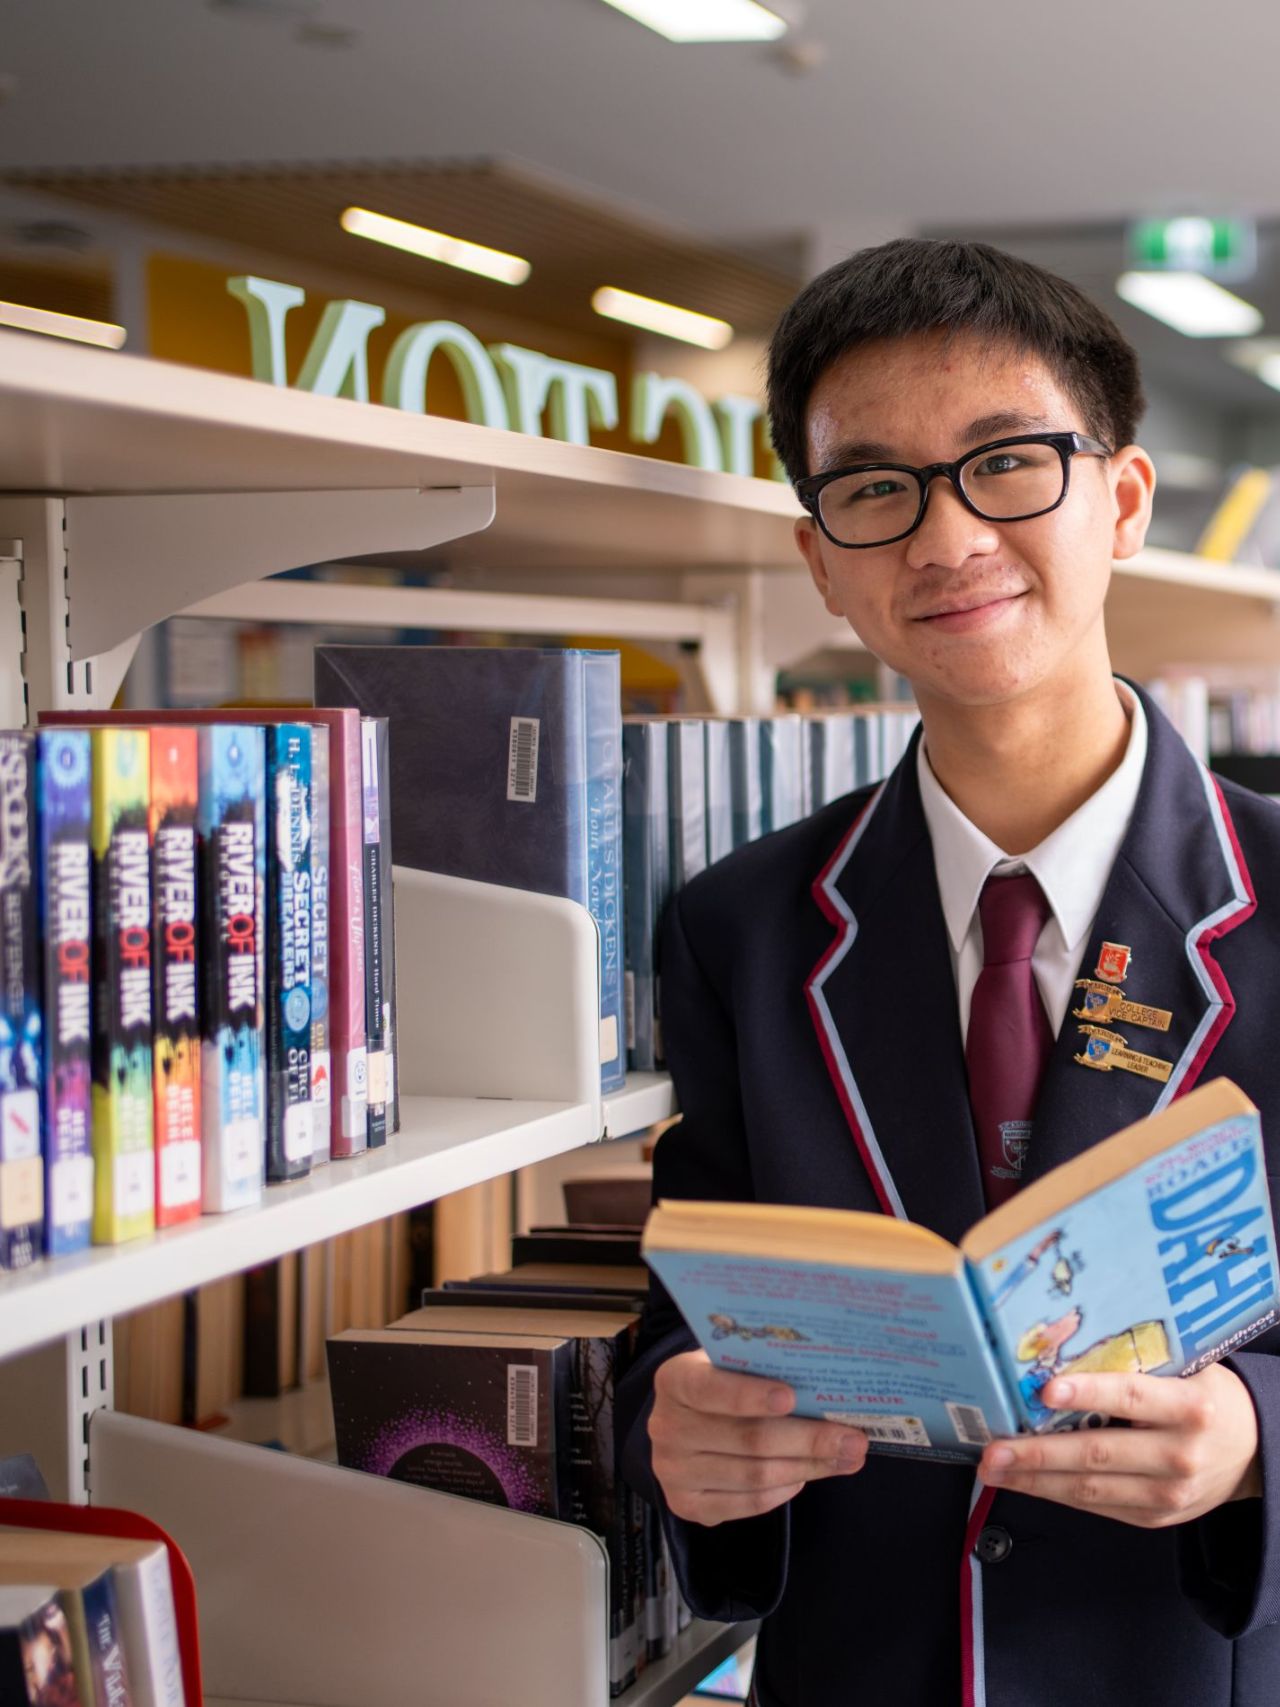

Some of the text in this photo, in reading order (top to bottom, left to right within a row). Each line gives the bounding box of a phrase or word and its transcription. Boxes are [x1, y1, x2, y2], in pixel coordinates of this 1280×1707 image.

[56, 842, 90, 1044] RIVER OF INK
[118, 830, 151, 1029] RIVER OF INK
[164, 827, 196, 1021] RIVER OF INK
[227, 823, 257, 1011] RIVER OF INK
[281, 872, 296, 990] BREAKERS
[292, 870, 311, 986] SECRET
[311, 866, 329, 977] SECRET
[589, 859, 603, 925] Novel
[602, 872, 617, 986] DICKENS
[1119, 1002, 1159, 1019] COLLEGE
[298, 1049, 309, 1099] CIRC
[1149, 1146, 1275, 1364] DAHL
[1198, 1308, 1277, 1362] Childhood
